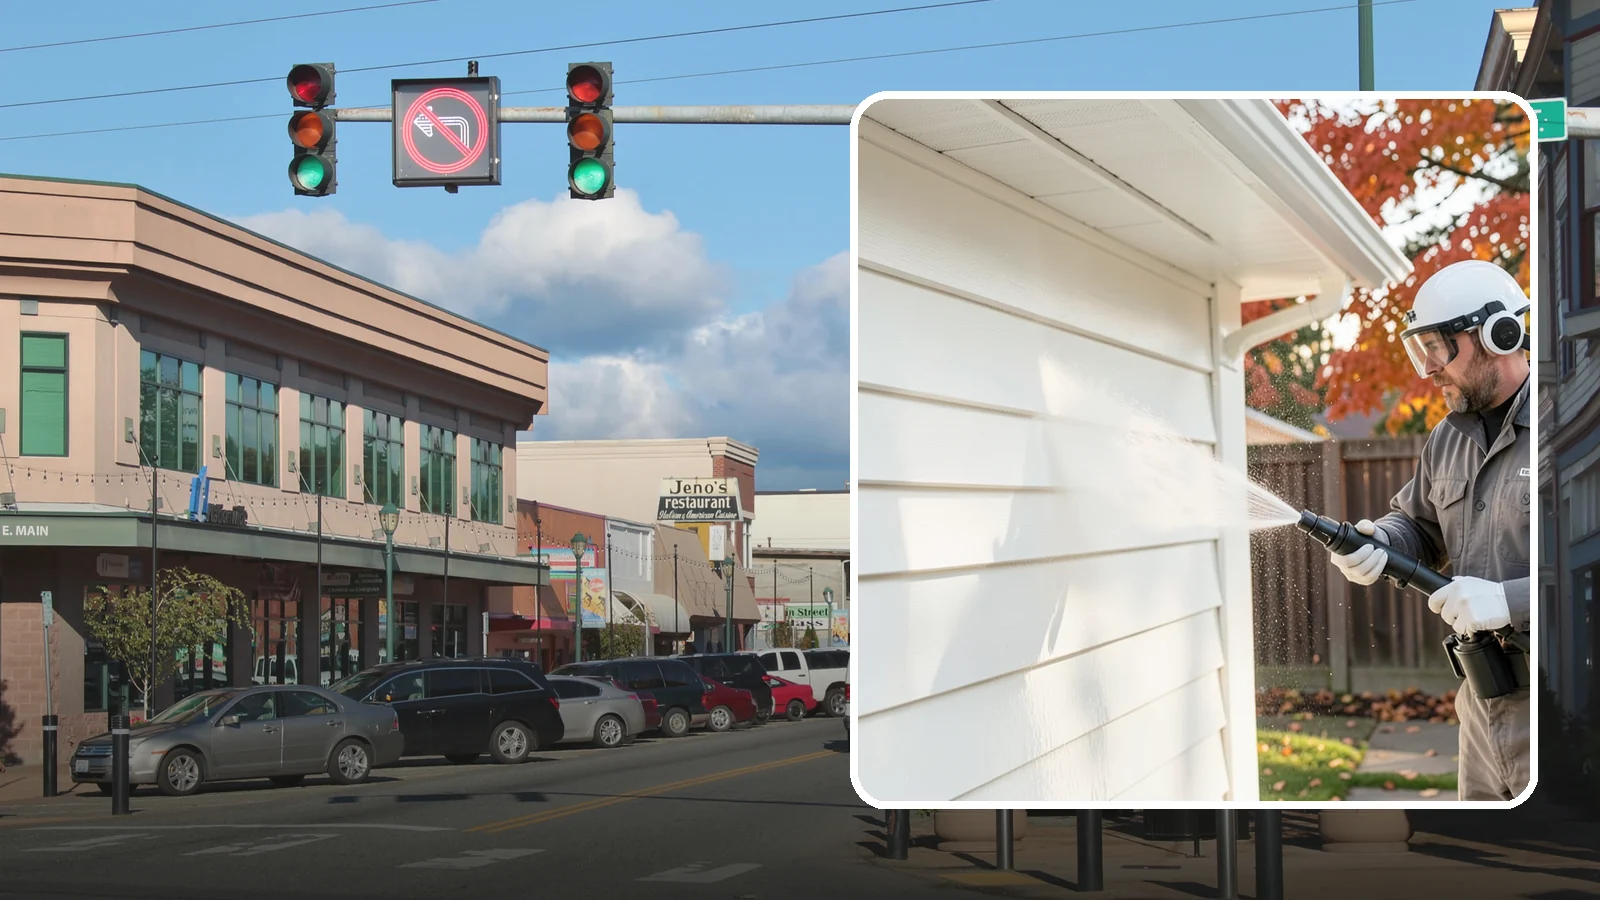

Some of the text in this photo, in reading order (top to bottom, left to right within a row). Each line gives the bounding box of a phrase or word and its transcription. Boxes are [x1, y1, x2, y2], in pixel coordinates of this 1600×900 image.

[670, 480, 727, 494] Jeno's
[665, 496, 731, 509] restaurant
[658, 510, 682, 519] Italian
[686, 510, 714, 519] American
[715, 509, 737, 519] Cuisine
[2, 525, 49, 536] E. MAIN
[797, 607, 828, 617] Street
[790, 619, 824, 627] lass
